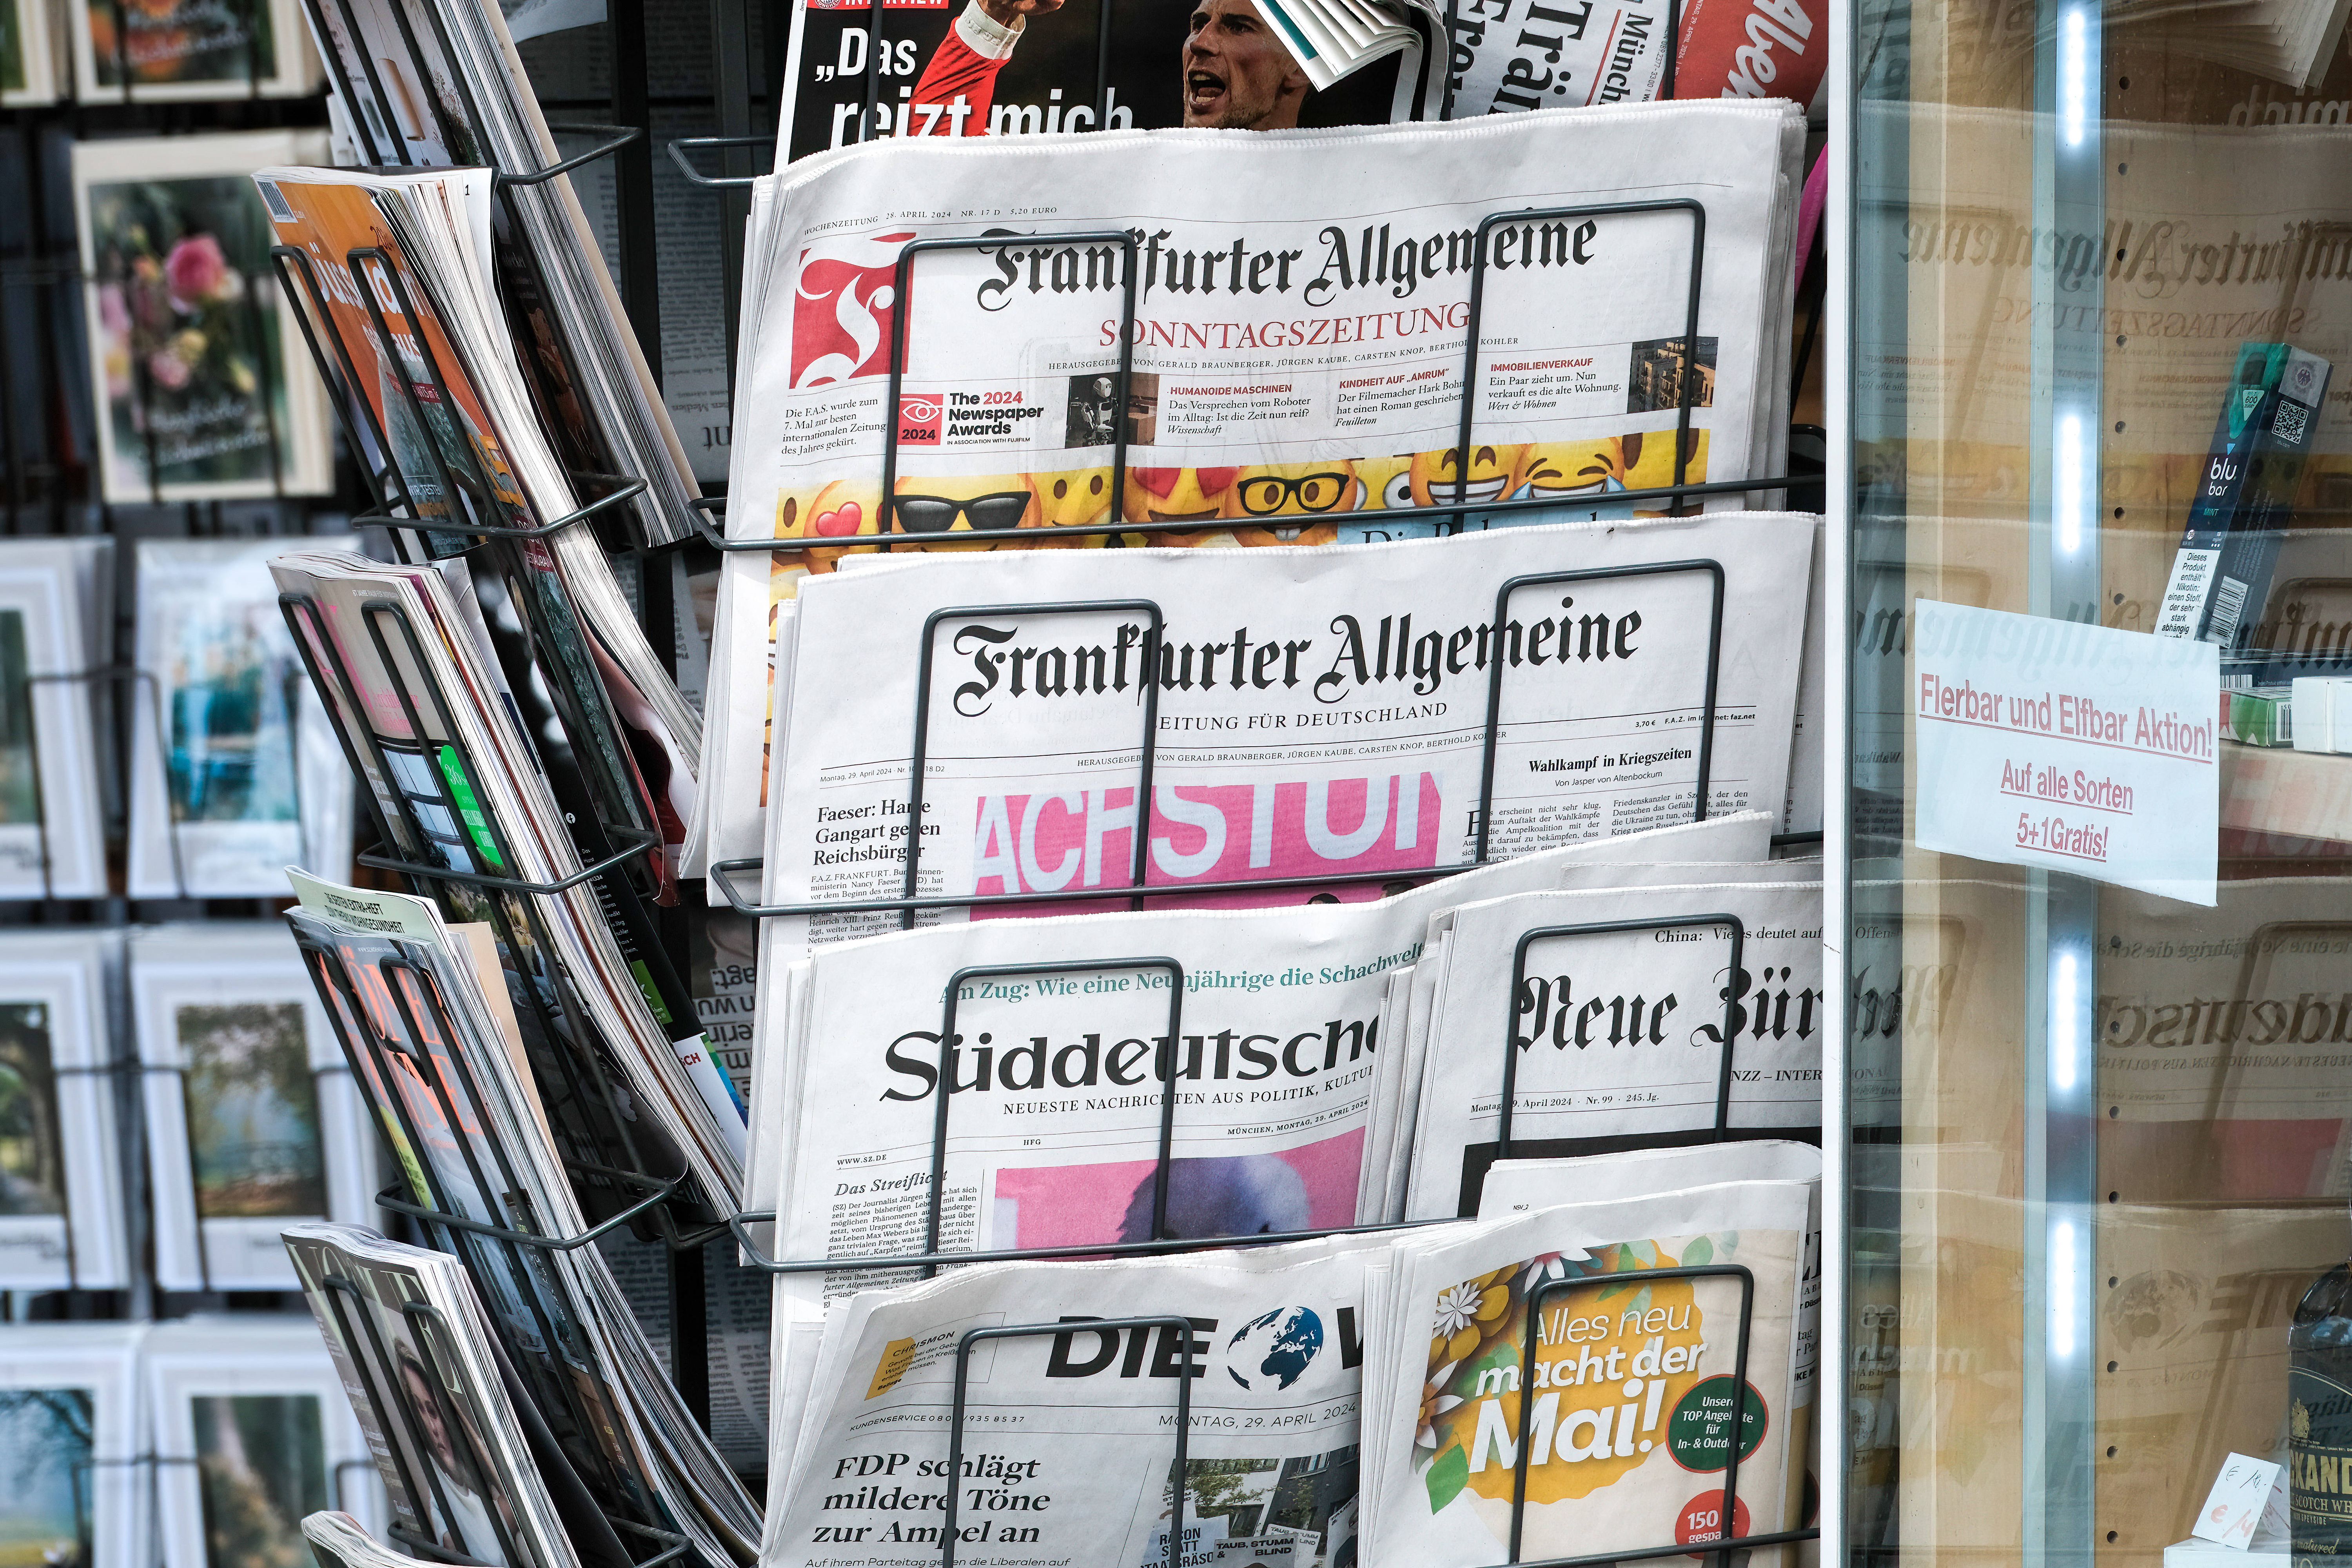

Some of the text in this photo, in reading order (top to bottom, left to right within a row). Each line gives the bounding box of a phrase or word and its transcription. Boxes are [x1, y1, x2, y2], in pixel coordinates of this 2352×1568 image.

[804, 216, 878, 235] WOCHENZEITUNG
[1100, 301, 1471, 348] SONNTAGSZEITUNG
[1491, 358, 1593, 372] IMMOBILIENVERKAUF
[950, 392, 1023, 405] The 2024
[1171, 384, 1291, 396] HUMANOIDE MASCHINEN
[786, 409, 802, 417] Die
[806, 405, 828, 416] F.A.S.
[831, 399, 856, 410] wurde
[1170, 401, 1187, 409] Das
[1190, 400, 1247, 411] Versprechen
[1274, 397, 1311, 406] Roboter
[2245, 396, 2258, 404] 600
[795, 420, 812, 429] Mal
[830, 412, 857, 424] besten
[949, 407, 1044, 422] Newspaper
[1183, 413, 1213, 424] Alltag:
[1248, 411, 1267, 419] Zeit
[1290, 409, 1309, 417] reif?
[782, 423, 887, 442] internationalen Zeitung
[902, 429, 936, 440] 2024
[947, 421, 1011, 436] Awards
[1168, 425, 1221, 436] Wissenschaft
[798, 444, 824, 455] Jahres
[826, 438, 856, 450] gekürt.
[2210, 457, 2237, 481] blu
[2208, 482, 2228, 496] bar
[2203, 508, 2219, 517] MINT
[2187, 553, 2207, 561] Dieses
[2182, 563, 2206, 571] Produkt
[2181, 573, 2201, 582] enthält
[2176, 583, 2200, 591] Nikotin:
[2186, 594, 2201, 602] Stoff,
[2162, 624, 2190, 634] abhängig
[1312, 598, 1642, 704] Allgemeine
[1156, 703, 1446, 730] EITUNG FÜR DEUTSCHLAND
[1921, 673, 2212, 758] Flerbar und Elfbar Aktion!
[1529, 748, 1691, 772] Wahlkampf in Kriegszeiten
[1613, 771, 1662, 781] Altenbockum
[2001, 759, 2133, 811] Auf alle Sorten
[817, 799, 931, 822] Faeser: Hae
[816, 824, 940, 844] Gangart geen
[813, 845, 925, 866] Reichsbürgr
[1655, 927, 1822, 943] China: Viees deutet auf
[980, 982, 1029, 1003] Zug:
[1035, 978, 1078, 996] Wie
[1084, 975, 1130, 994] eine
[1280, 968, 1313, 986] die
[1518, 975, 1678, 1052] Neue
[1004, 1100, 1078, 1114] NEUESTE
[1212, 1093, 1243, 1103] AUS
[1250, 1085, 1318, 1102] POLITIK,
[1523, 1099, 1547, 1109] April
[1647, 1093, 1659, 1102] Jg.
[1277, 1120, 1312, 1131] MONTAG,
[1328, 1107, 1349, 1118] APRIL
[1351, 1100, 1368, 1111] 2024
[837, 1154, 887, 1166] WWW.SZ.DE
[834, 1170, 947, 1196] Das Streiflict
[1521, 1303, 1691, 1348] Alles neu
[893, 1331, 955, 1357] CHRISMON
[1046, 1316, 1218, 1378] DIE
[1632, 1335, 1708, 1381] der
[1245, 1418, 1265, 1427] 29.
[1271, 1413, 1316, 1426] APRIL
[1324, 1401, 1357, 1419] 2024
[1682, 1410, 1702, 1423] TOP
[1468, 1378, 1666, 1474] Mai!
[1706, 1423, 1720, 1435] für
[832, 1454, 909, 1479] FDP
[822, 1487, 1050, 1511] mildere Töne
[2295, 1494, 2328, 1511] SCOTCH
[1687, 1510, 1719, 1530] 150
[2301, 1514, 2327, 1525] SPEYSIDE
[812, 1527, 872, 1542] zur
[999, 1528, 1039, 1542] an
[1251, 1537, 1294, 1547] STUMM
[1255, 1547, 1292, 1556] BLIND
